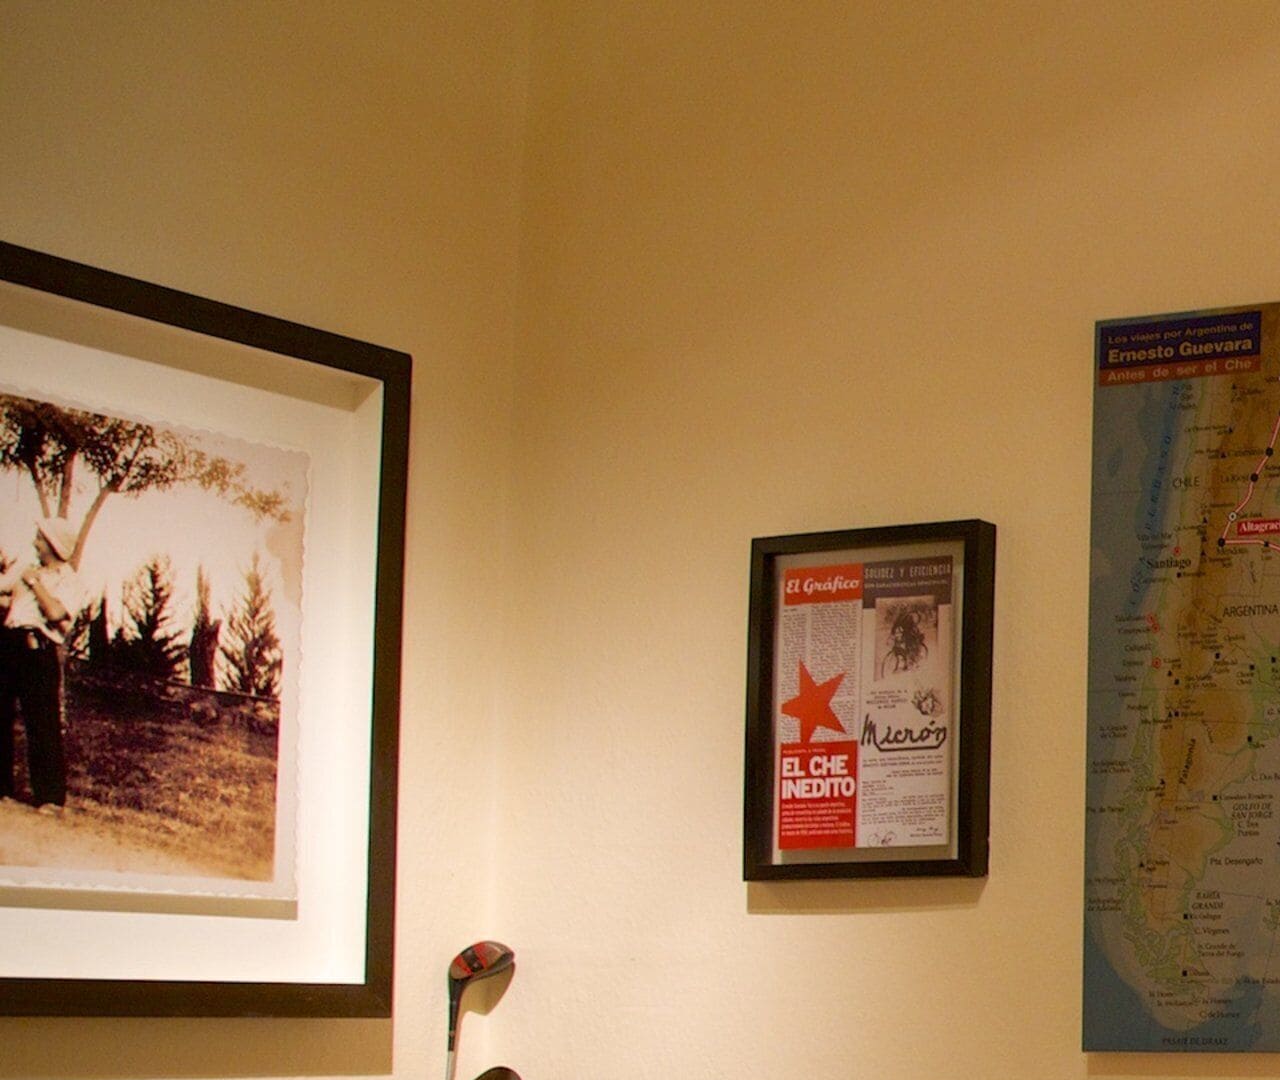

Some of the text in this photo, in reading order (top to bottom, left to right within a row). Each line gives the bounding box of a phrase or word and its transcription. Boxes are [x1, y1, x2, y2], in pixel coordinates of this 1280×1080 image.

[1108, 322, 1254, 345] Los viajes por Argentina de
[1107, 338, 1253, 364] Ernesto Guevara
[1107, 358, 1252, 382] Antes de ser el Che
[1172, 476, 1200, 488] CHILE
[864, 564, 952, 580] SOLIDEZ Y EFICIENCIA
[1147, 557, 1192, 570] Santiago
[785, 575, 861, 596] El Gráfico
[1222, 604, 1279, 618] ARGENTINA
[860, 713, 947, 750] Micrón
[782, 756, 806, 778] EL
[809, 755, 848, 777] CHE
[781, 776, 856, 800] INEDITO
